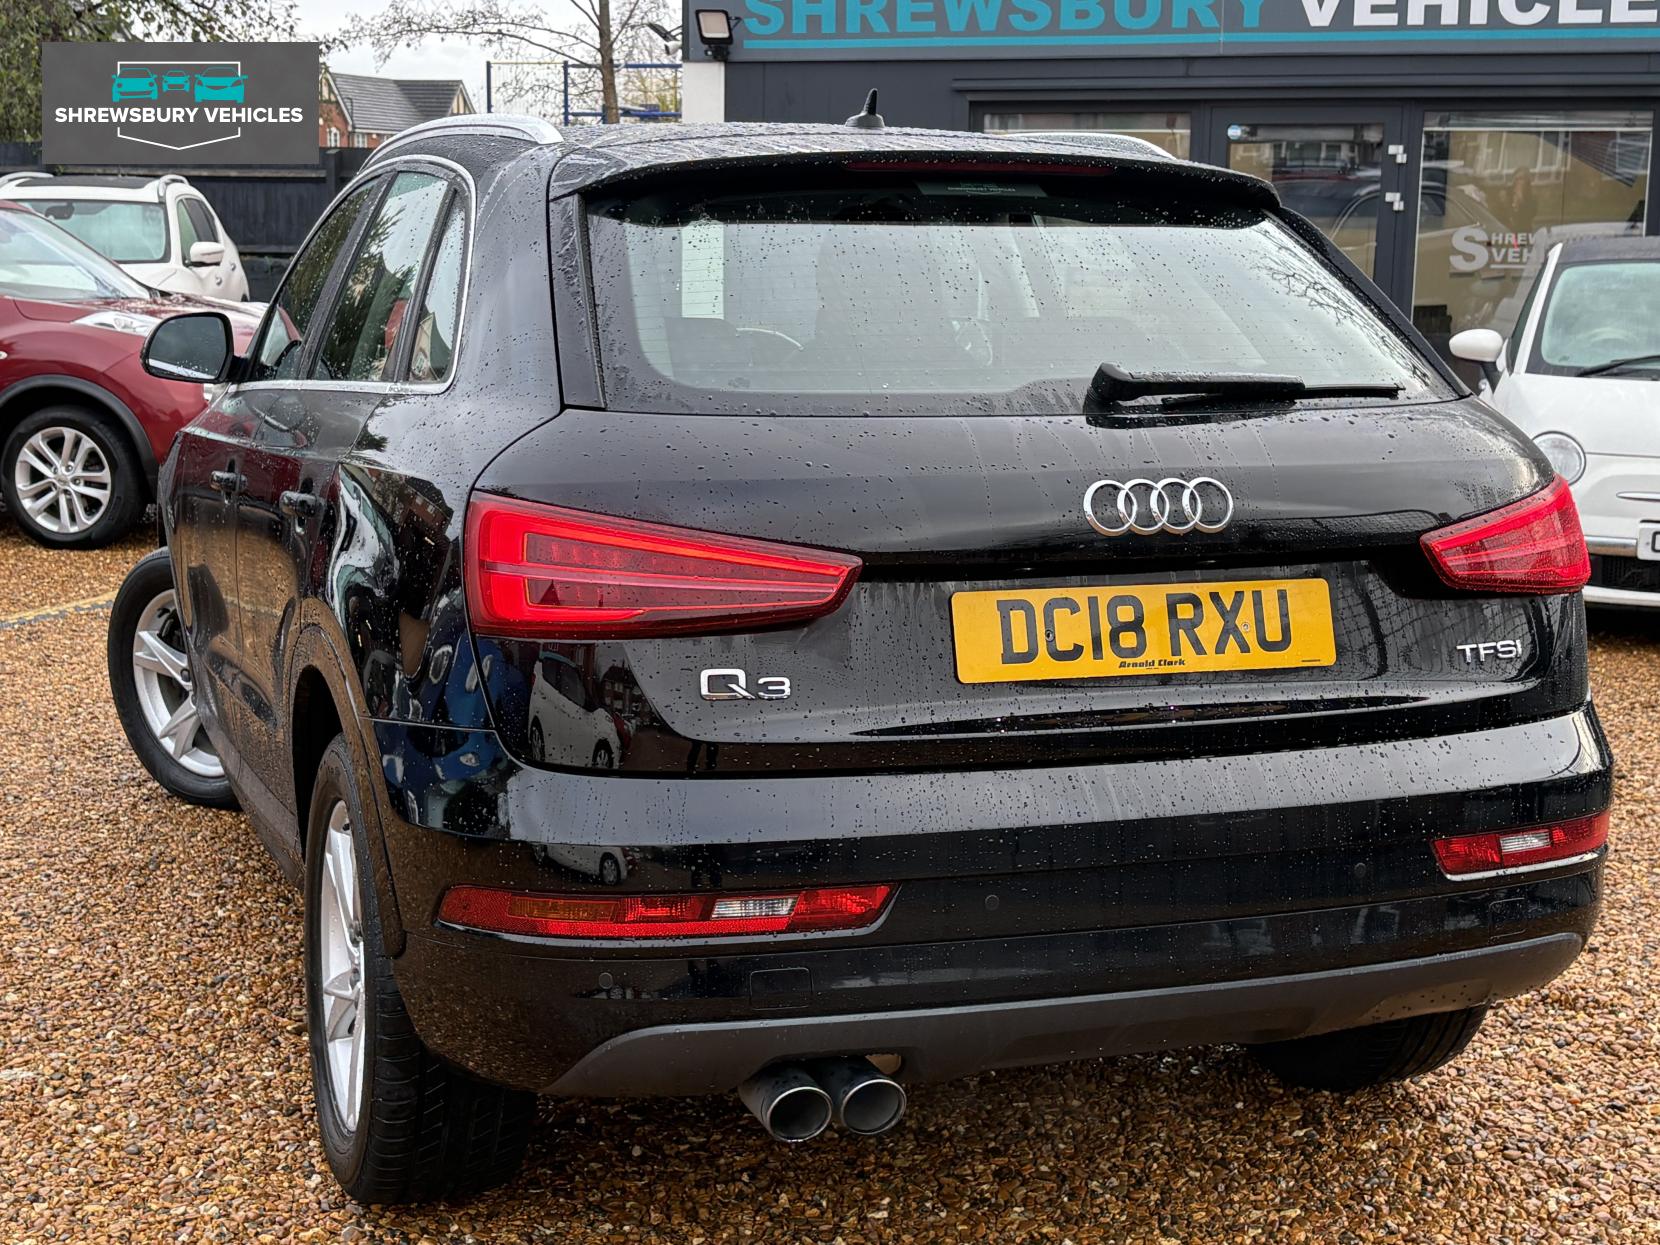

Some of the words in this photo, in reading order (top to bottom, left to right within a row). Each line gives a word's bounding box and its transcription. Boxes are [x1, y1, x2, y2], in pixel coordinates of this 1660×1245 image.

[744, 0, 1264, 35] SHREWSBURY
[996, 594, 1147, 665] DC18
[1165, 588, 1292, 657] RXU
[1119, 659, 1155, 669] Arnold
[1158, 659, 1186, 667] Clark
[1456, 639, 1522, 663] TFSI
[700, 668, 791, 701] Q3
